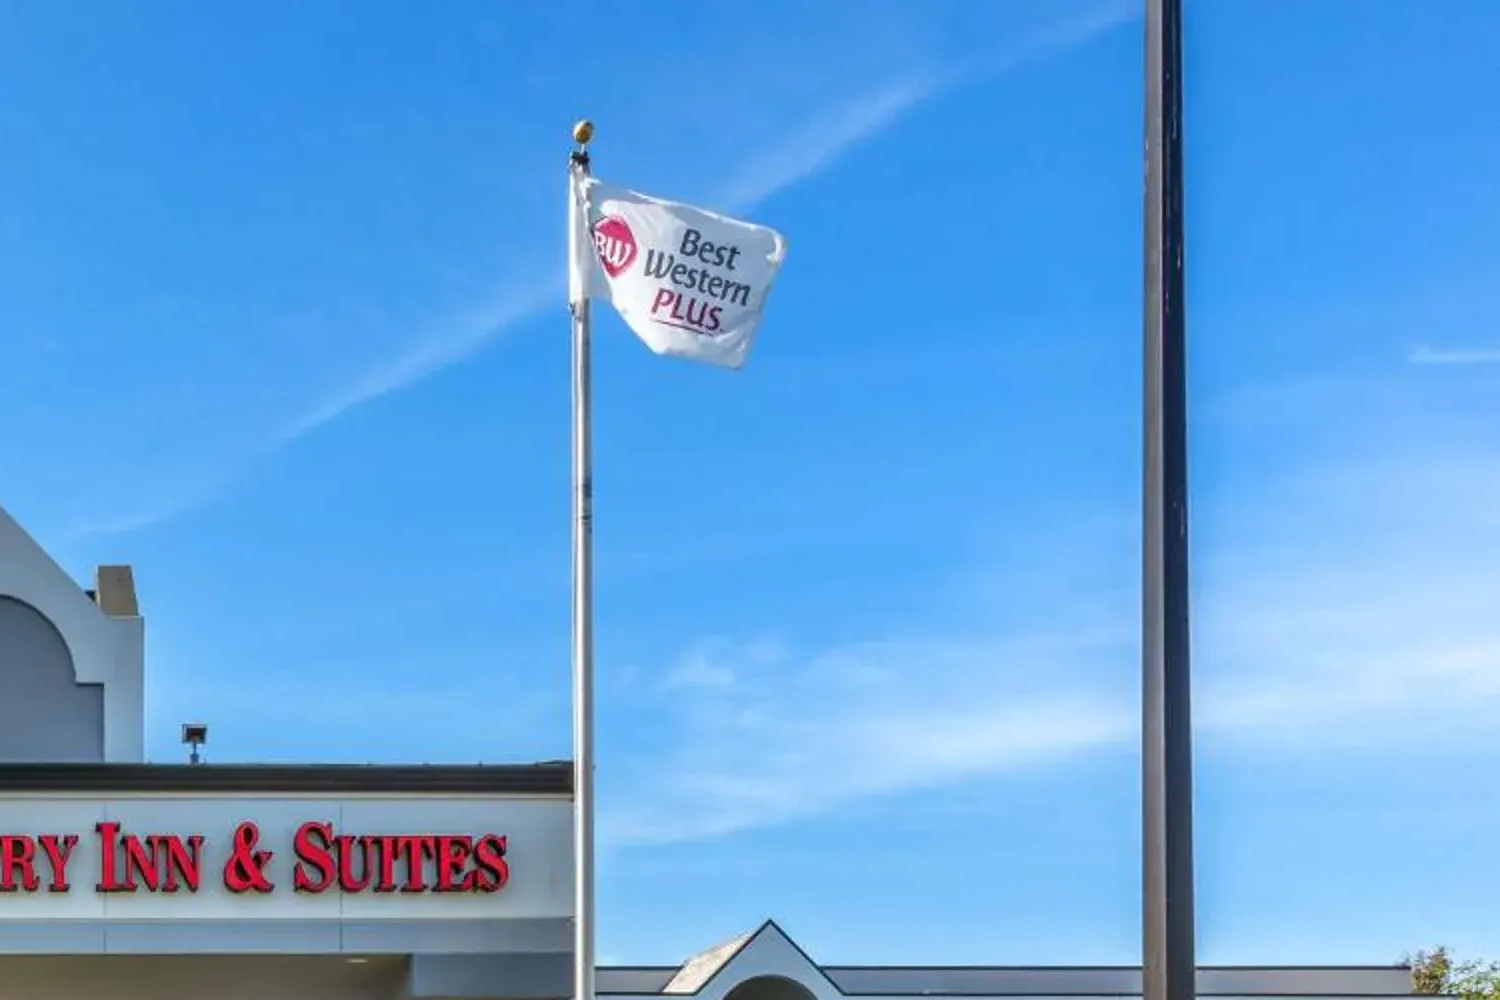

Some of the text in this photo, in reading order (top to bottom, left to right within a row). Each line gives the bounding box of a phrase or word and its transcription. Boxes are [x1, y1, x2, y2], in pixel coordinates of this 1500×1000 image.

[680, 229, 741, 271] Best
[643, 249, 752, 307] Western
[651, 288, 724, 331] PLUS
[96, 822, 203, 893] INN
[224, 821, 275, 893] &
[294, 821, 509, 893] SUITES
